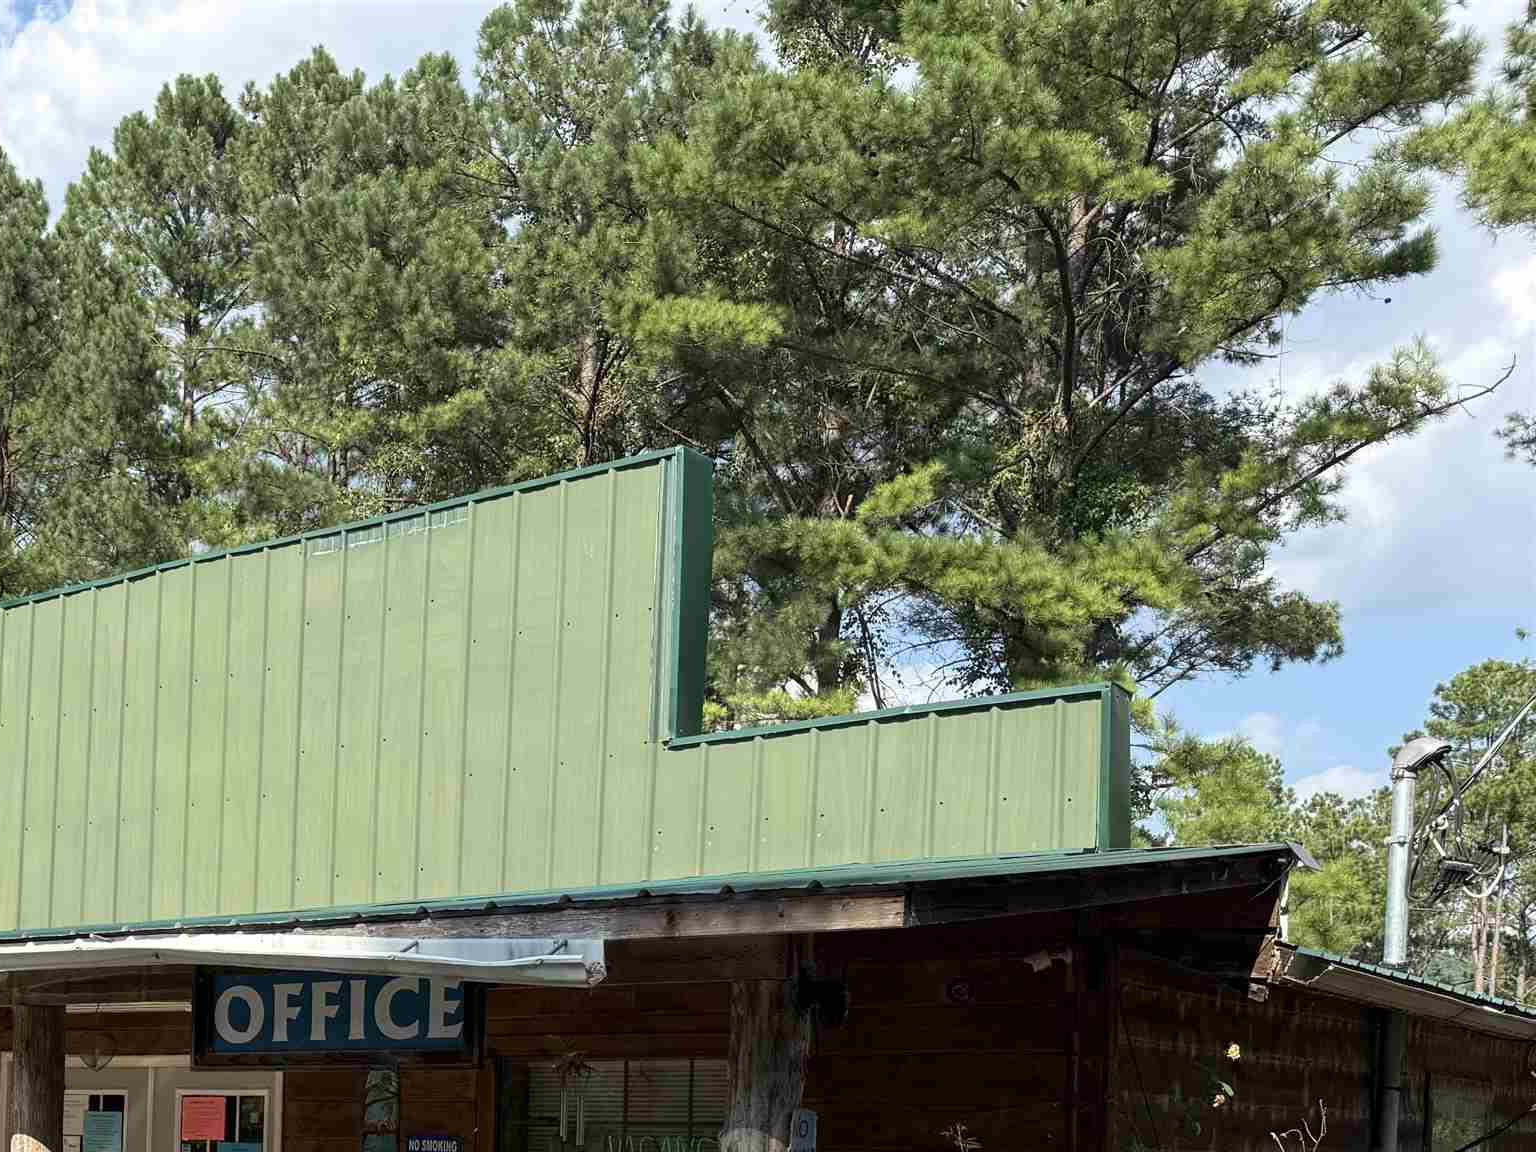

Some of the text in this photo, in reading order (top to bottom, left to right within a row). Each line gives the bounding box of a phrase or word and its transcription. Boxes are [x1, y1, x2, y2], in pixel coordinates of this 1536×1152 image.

[214, 976, 464, 1044] OFFICE
[408, 1139, 457, 1152] NO SMOKING
